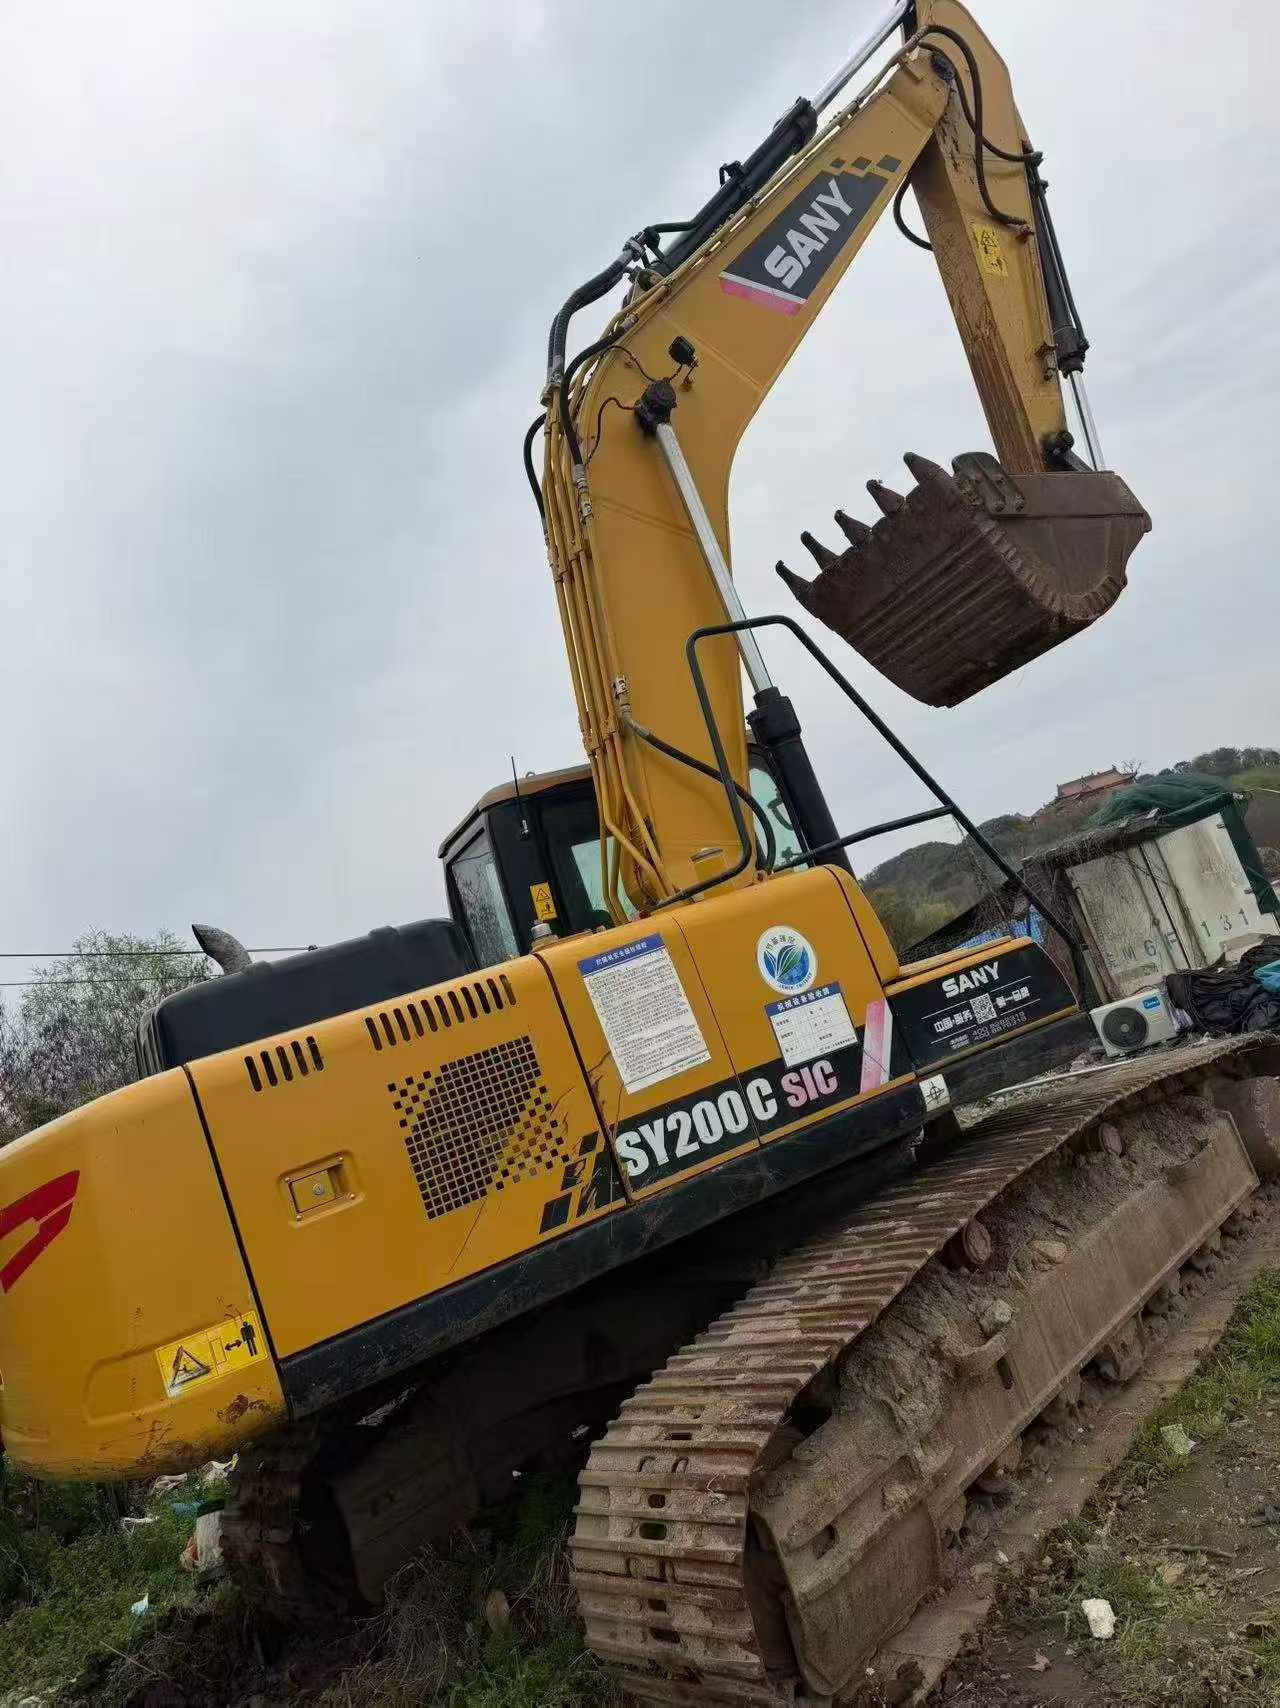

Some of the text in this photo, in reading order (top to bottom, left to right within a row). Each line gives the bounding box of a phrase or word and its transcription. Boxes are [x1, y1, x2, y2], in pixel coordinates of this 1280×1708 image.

[764, 178, 854, 290] SANY
[942, 961, 999, 998] SANY
[615, 1059, 838, 1177] SY200C SIC
